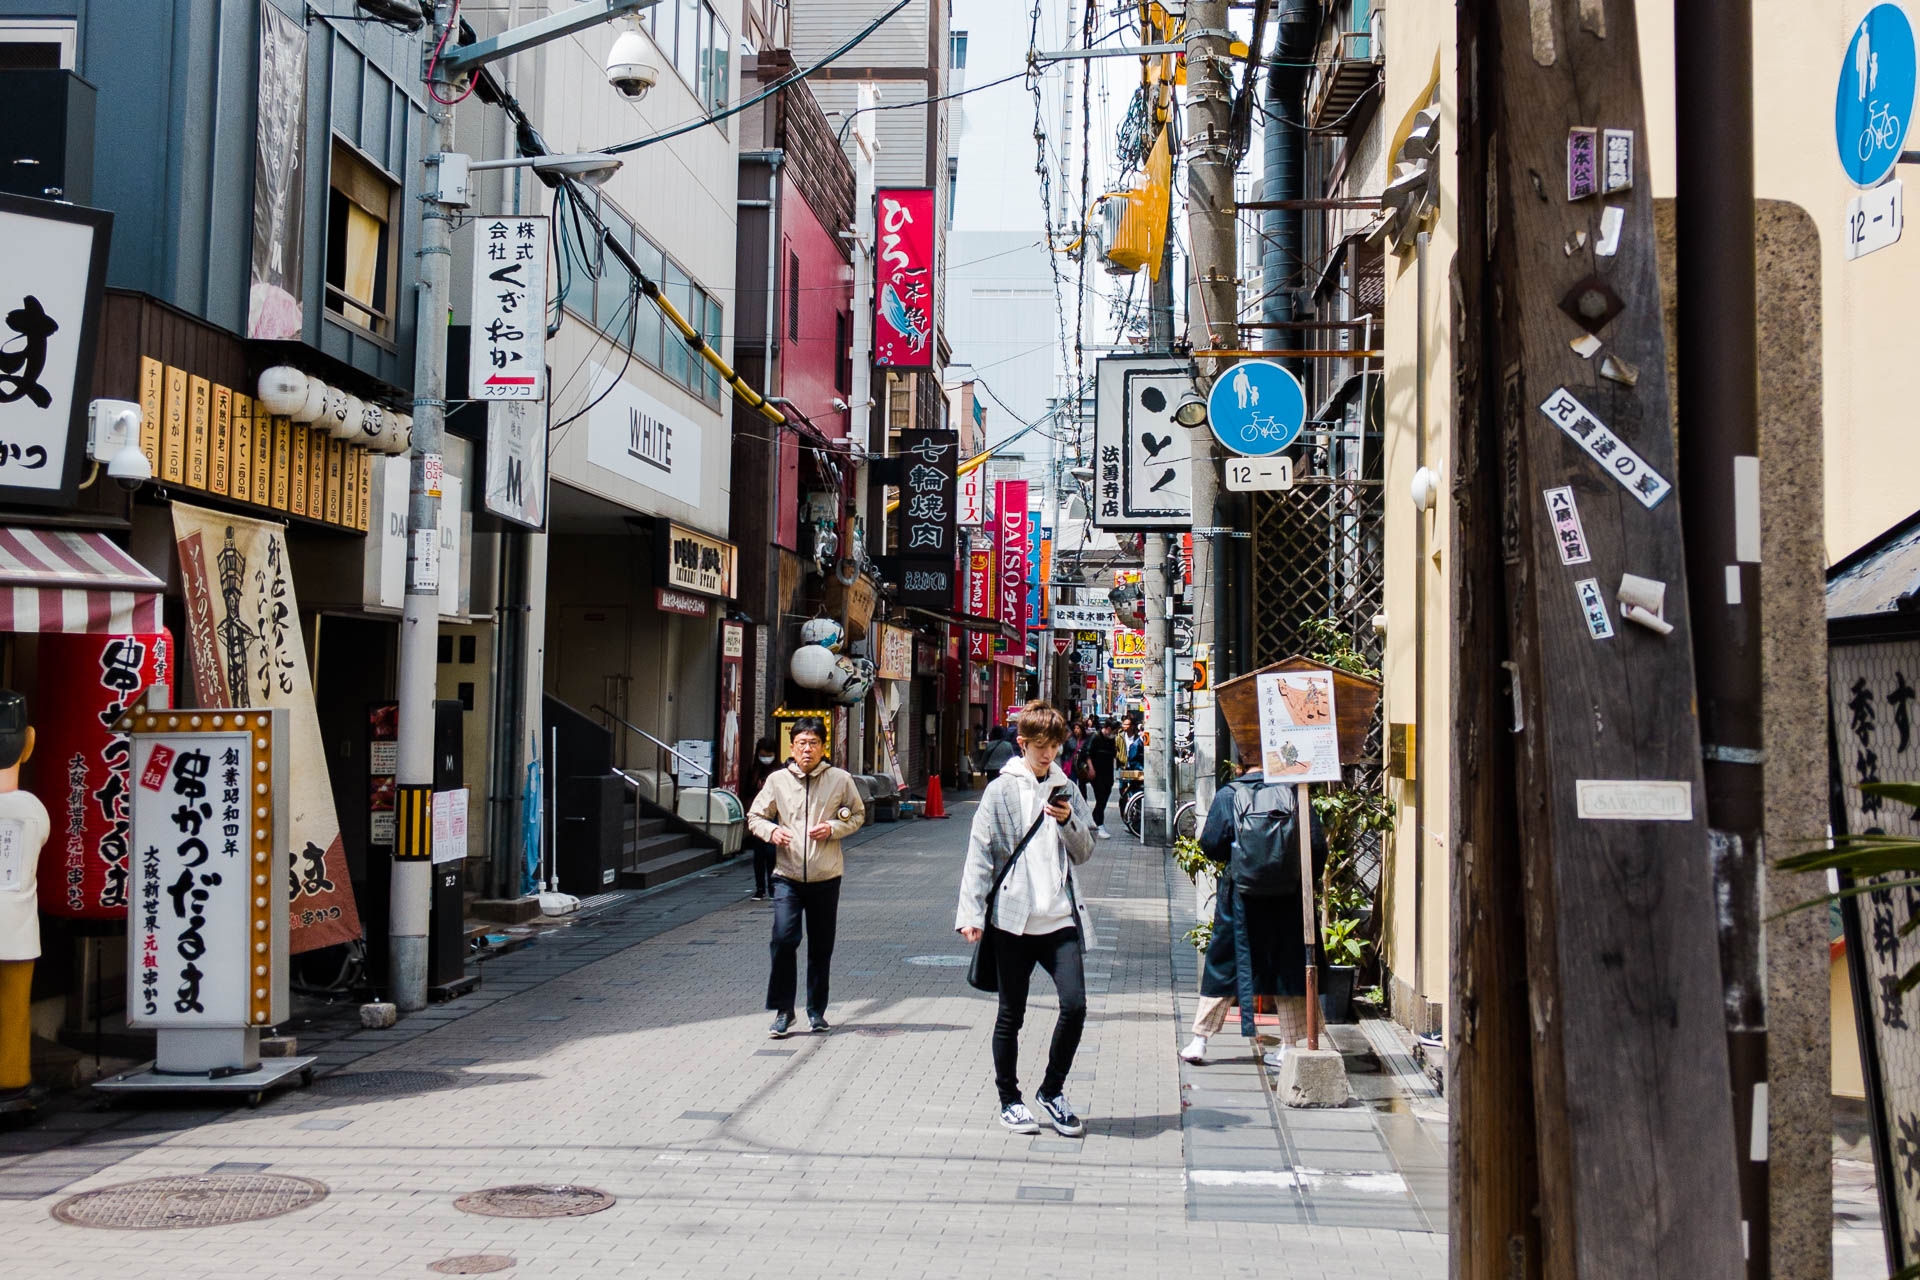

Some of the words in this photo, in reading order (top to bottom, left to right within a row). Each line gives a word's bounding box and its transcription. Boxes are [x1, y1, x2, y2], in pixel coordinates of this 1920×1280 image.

[488, 221, 509, 261] 会社
[516, 222, 536, 261] 株式
[484, 264, 526, 369] くぎおか
[485, 386, 531, 396] スグソコ
[629, 406, 672, 466] WHITE
[432, 481, 439, 490] A
[908, 437, 949, 549] 七輪焼肉
[1101, 445, 1120, 518] 法善寺店
[1232, 465, 1287, 483] 12-1
[1004, 511, 1023, 587] DAISO
[141, 749, 170, 789] 元祖
[219, 746, 241, 859] 創業昭和四年
[66, 752, 89, 911] 大阪新世界元祖串かつ
[167, 748, 223, 1014] 串かつだるま
[142, 845, 162, 1017] 大阪新世界元祖串かつ
